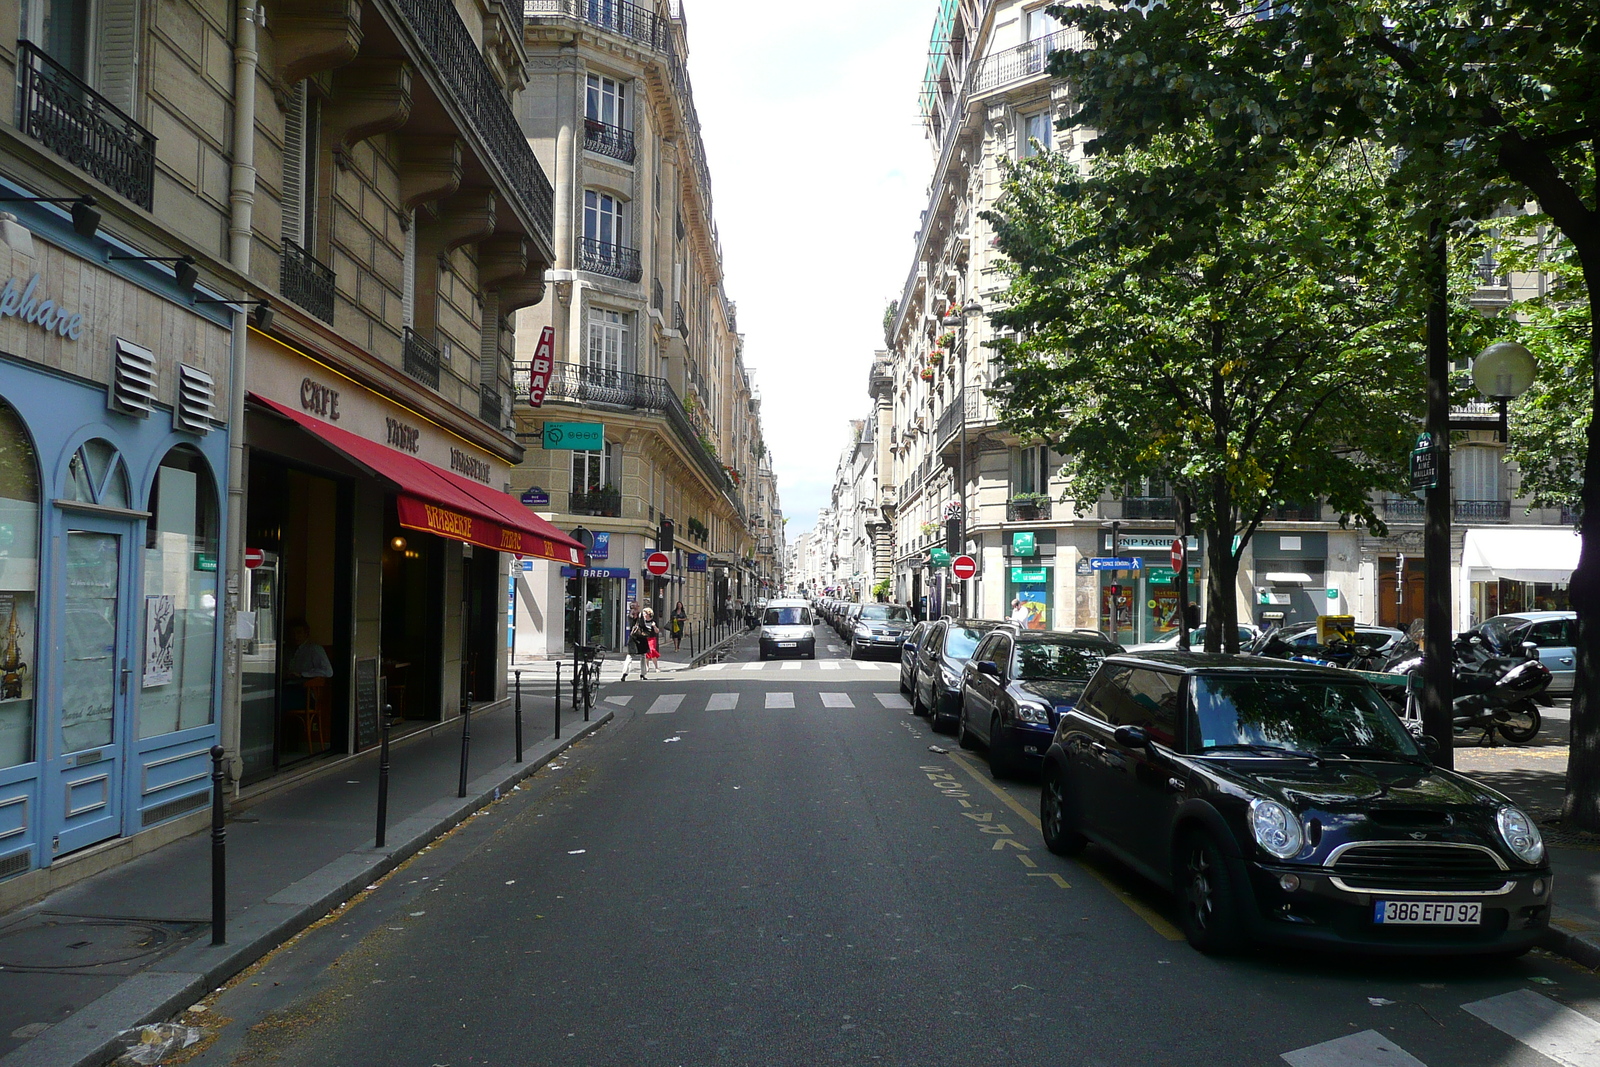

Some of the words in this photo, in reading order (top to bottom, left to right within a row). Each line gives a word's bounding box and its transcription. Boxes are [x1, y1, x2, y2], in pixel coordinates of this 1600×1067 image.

[0, 272, 84, 340] phare
[530, 329, 553, 403] TABAC
[385, 416, 420, 454] TABAC
[450, 447, 492, 484] BRASSERIE
[1417, 454, 1431, 463] PLACE
[424, 504, 473, 538] BRASSERIE
[501, 529, 522, 550] TABAC
[583, 569, 610, 578] BRED
[1387, 903, 1420, 921] 386
[1423, 904, 1455, 921] EFD
[1457, 905, 1479, 922] 92
